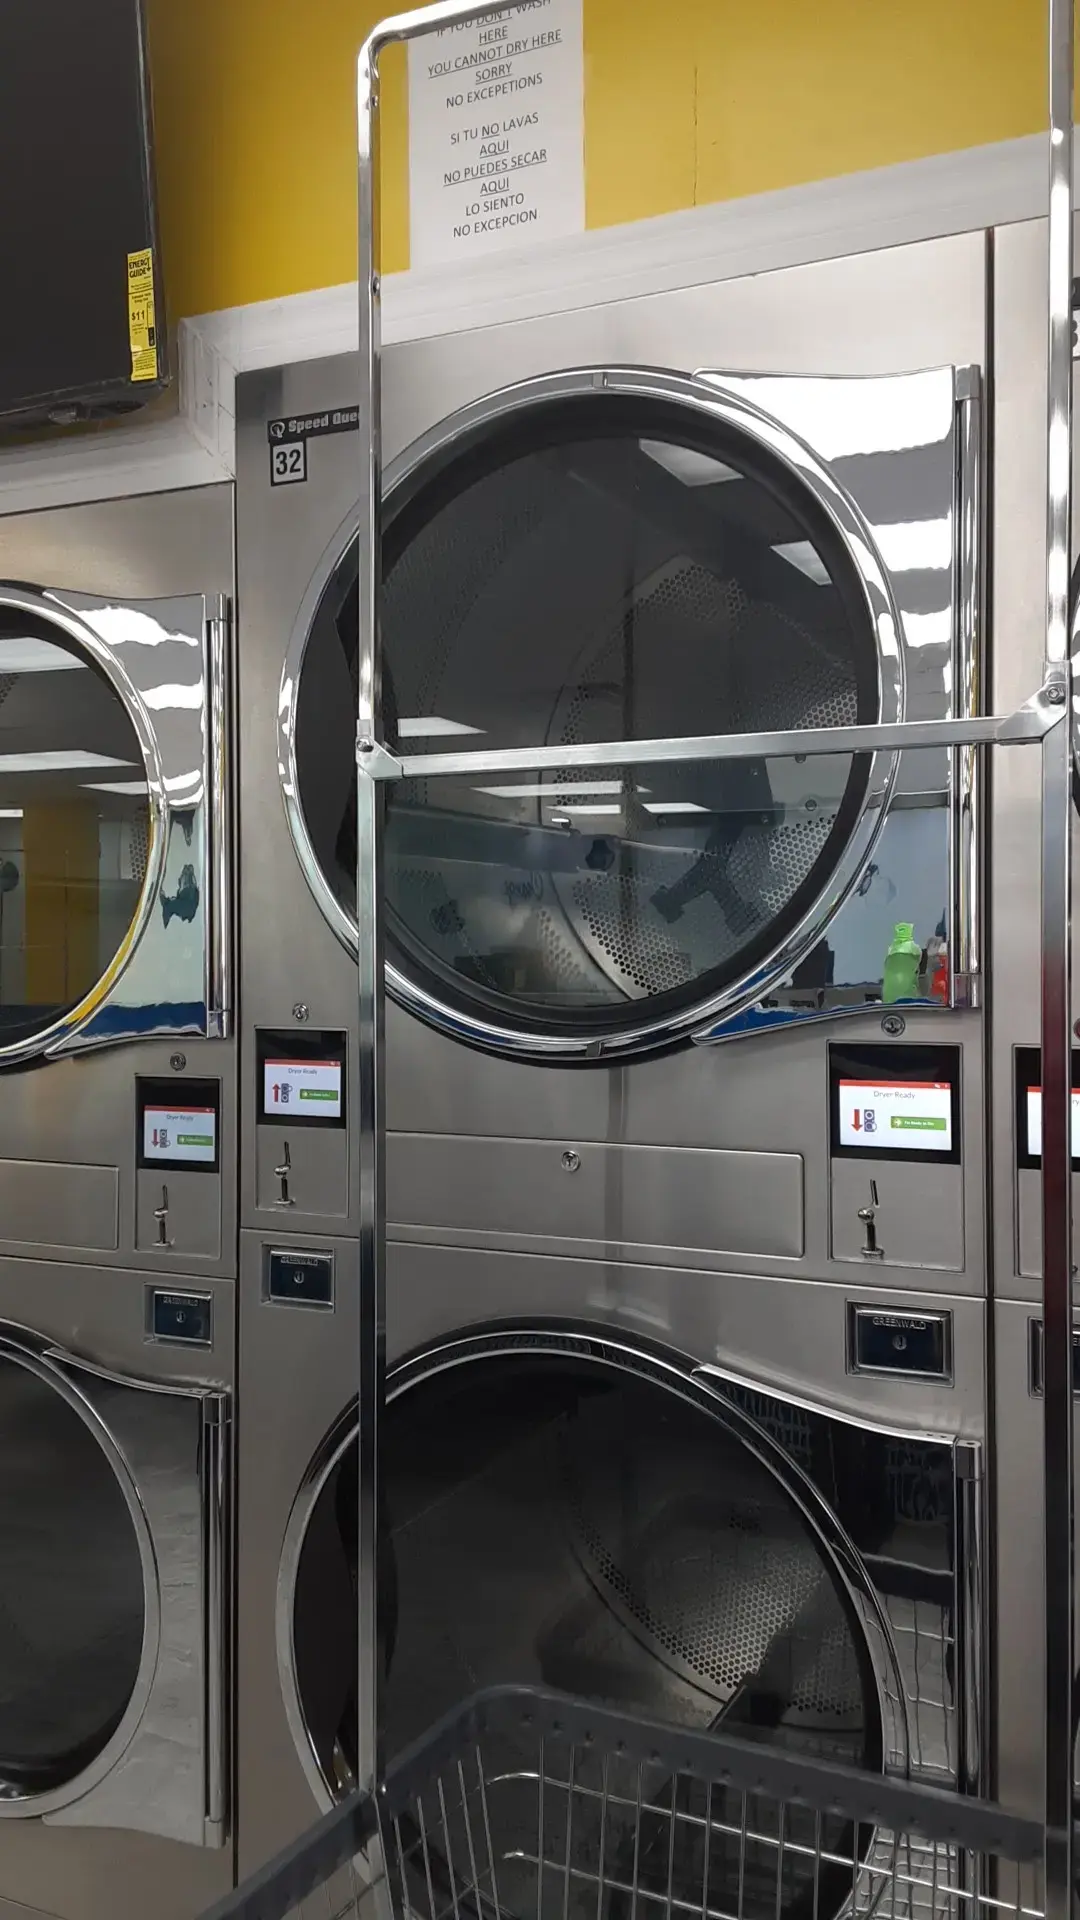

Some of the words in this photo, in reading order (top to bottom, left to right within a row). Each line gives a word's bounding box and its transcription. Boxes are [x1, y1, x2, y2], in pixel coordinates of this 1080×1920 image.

[476, 8, 512, 27] DONT
[479, 25, 508, 45] HERE
[428, 61, 451, 77] YOU
[454, 46, 502, 69] CANNOT
[506, 39, 528, 56] DRY
[532, 29, 562, 48] HERE
[475, 62, 512, 83] SORRY
[446, 94, 464, 108] NO
[467, 73, 543, 103] EXCEPETIONS
[450, 132, 460, 145] SI
[463, 128, 478, 141] TU
[481, 123, 500, 138] NO
[503, 112, 539, 132] LAVAS
[480, 140, 509, 157] AQUI
[443, 170, 460, 185] NO
[464, 158, 508, 179] PUEDES
[511, 149, 547, 168] SECAR
[480, 177, 509, 195] AQUI
[465, 203, 480, 216] LO
[483, 193, 524, 213] SIENTO
[453, 224, 471, 237] NO
[474, 209, 537, 233] EXCEPCION
[130, 267, 147, 278] GUIDE
[131, 310, 145, 320] $11
[288, 414, 329, 433] Speed
[332, 411, 359, 425] Que
[275, 449, 302, 475] 32
[873, 1091, 894, 1099] Dryer
[894, 1091, 916, 1099] Ready
[872, 1316, 926, 1330] GREENWALD
